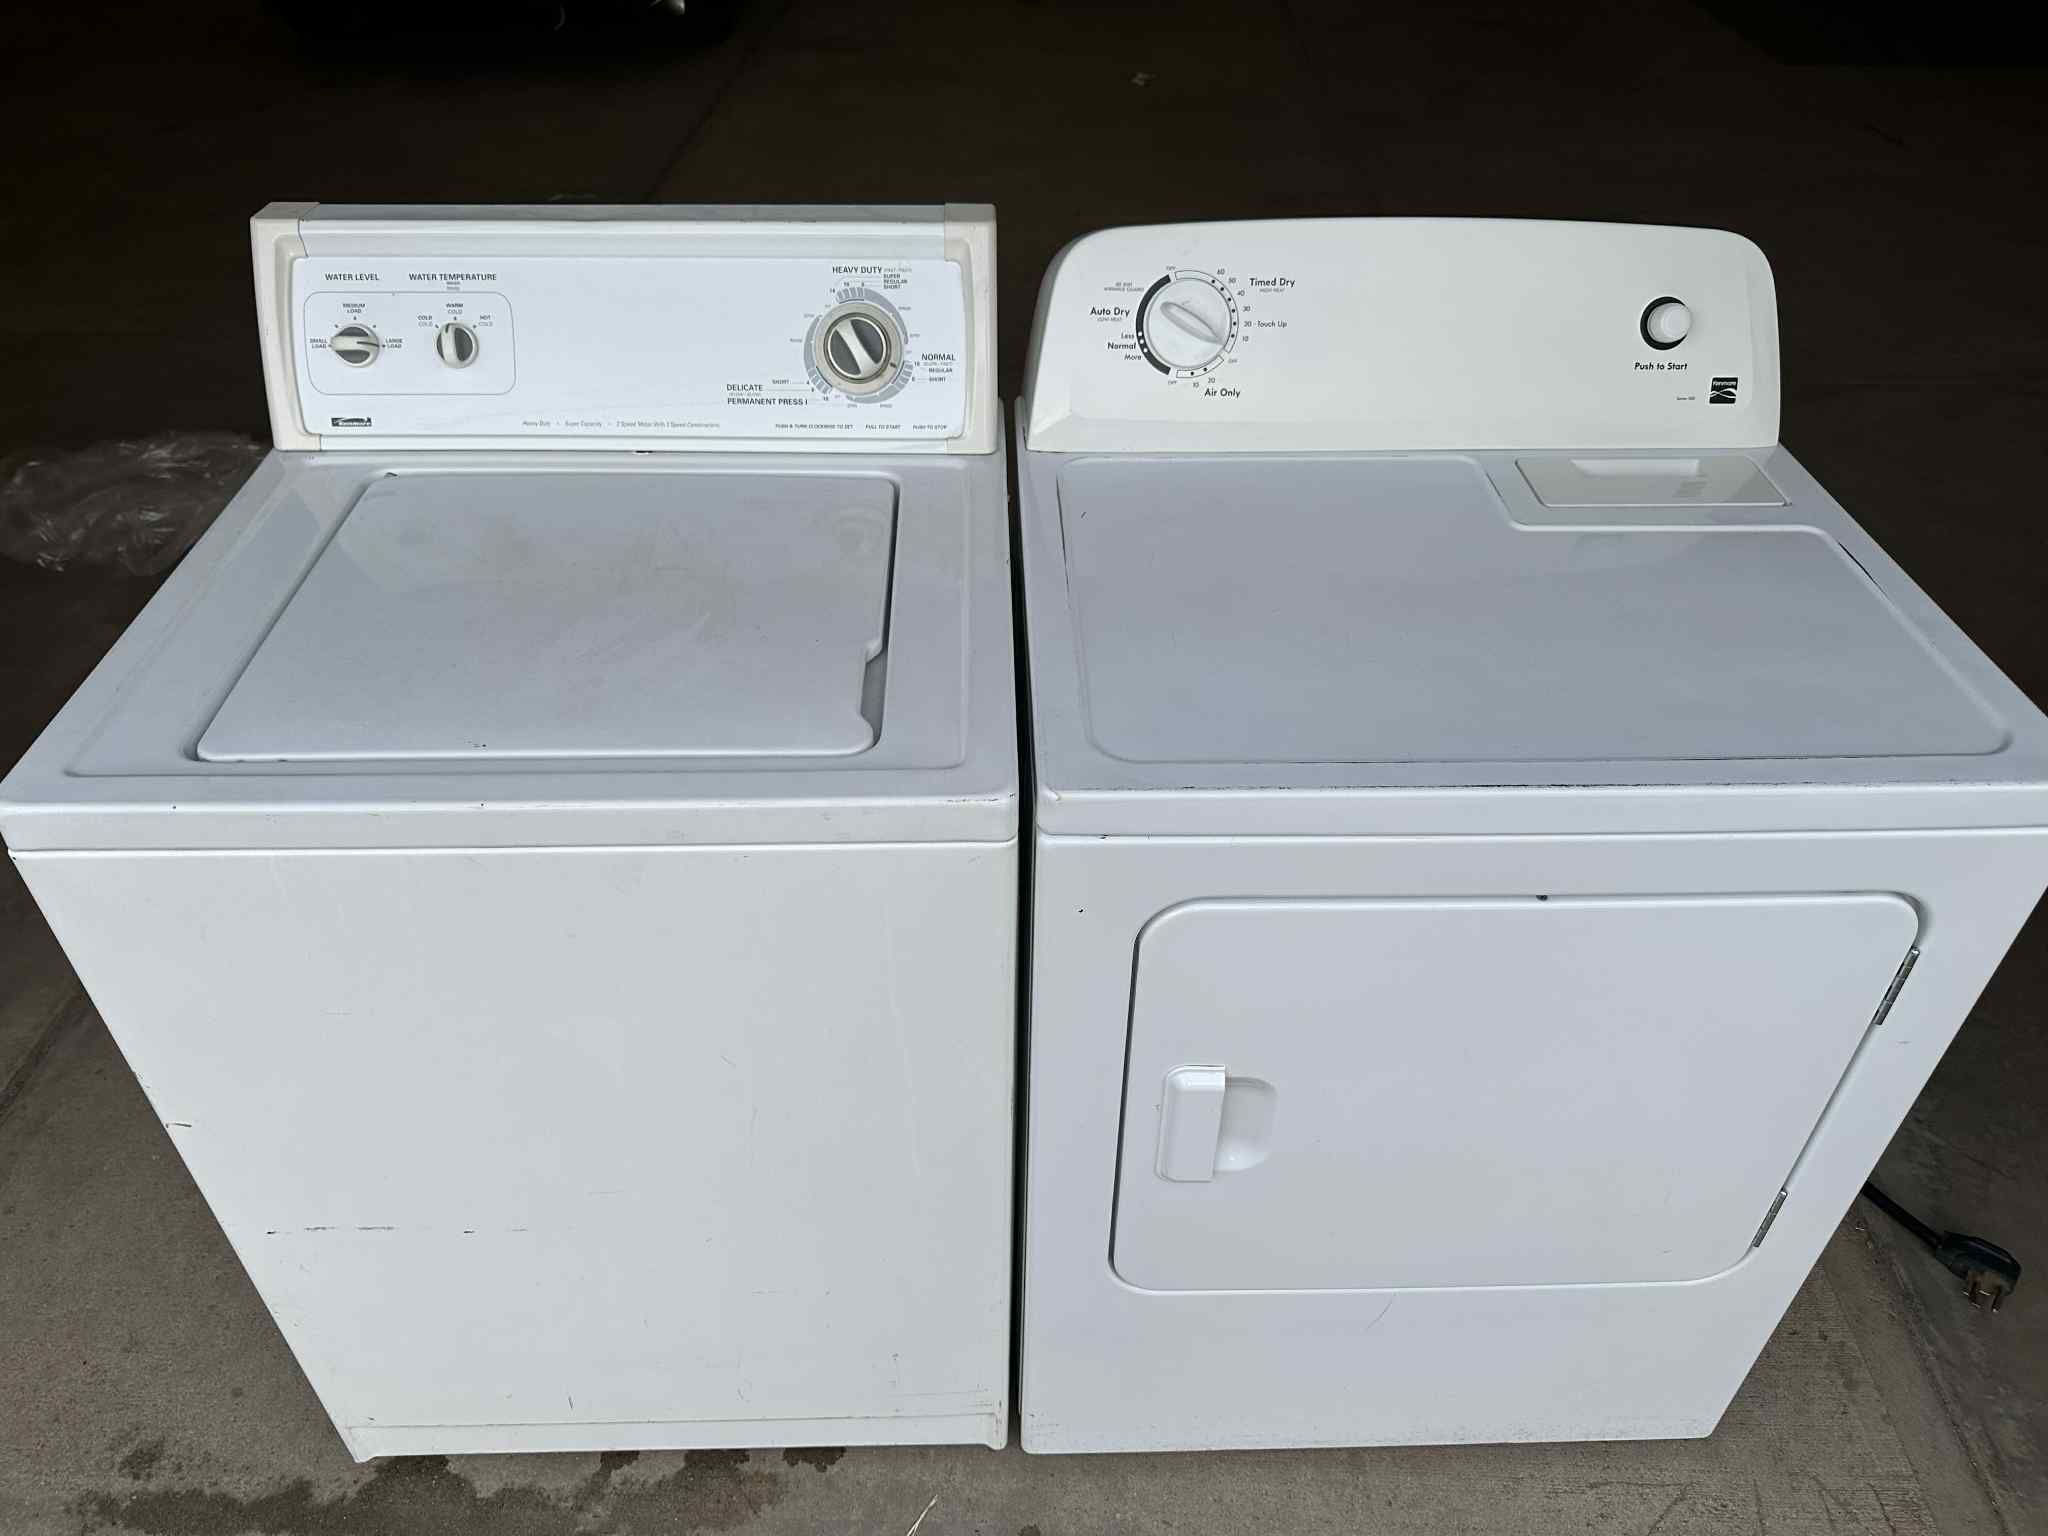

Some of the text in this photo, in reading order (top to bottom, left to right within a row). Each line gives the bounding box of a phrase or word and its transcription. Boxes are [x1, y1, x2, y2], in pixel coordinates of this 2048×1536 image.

[1249, 277, 1296, 288] Timed Dry
[1090, 306, 1130, 318] Auto Dry
[1278, 320, 1287, 328] Up
[1634, 362, 1688, 370] Push to Start
[1204, 388, 1240, 398] Air Only
